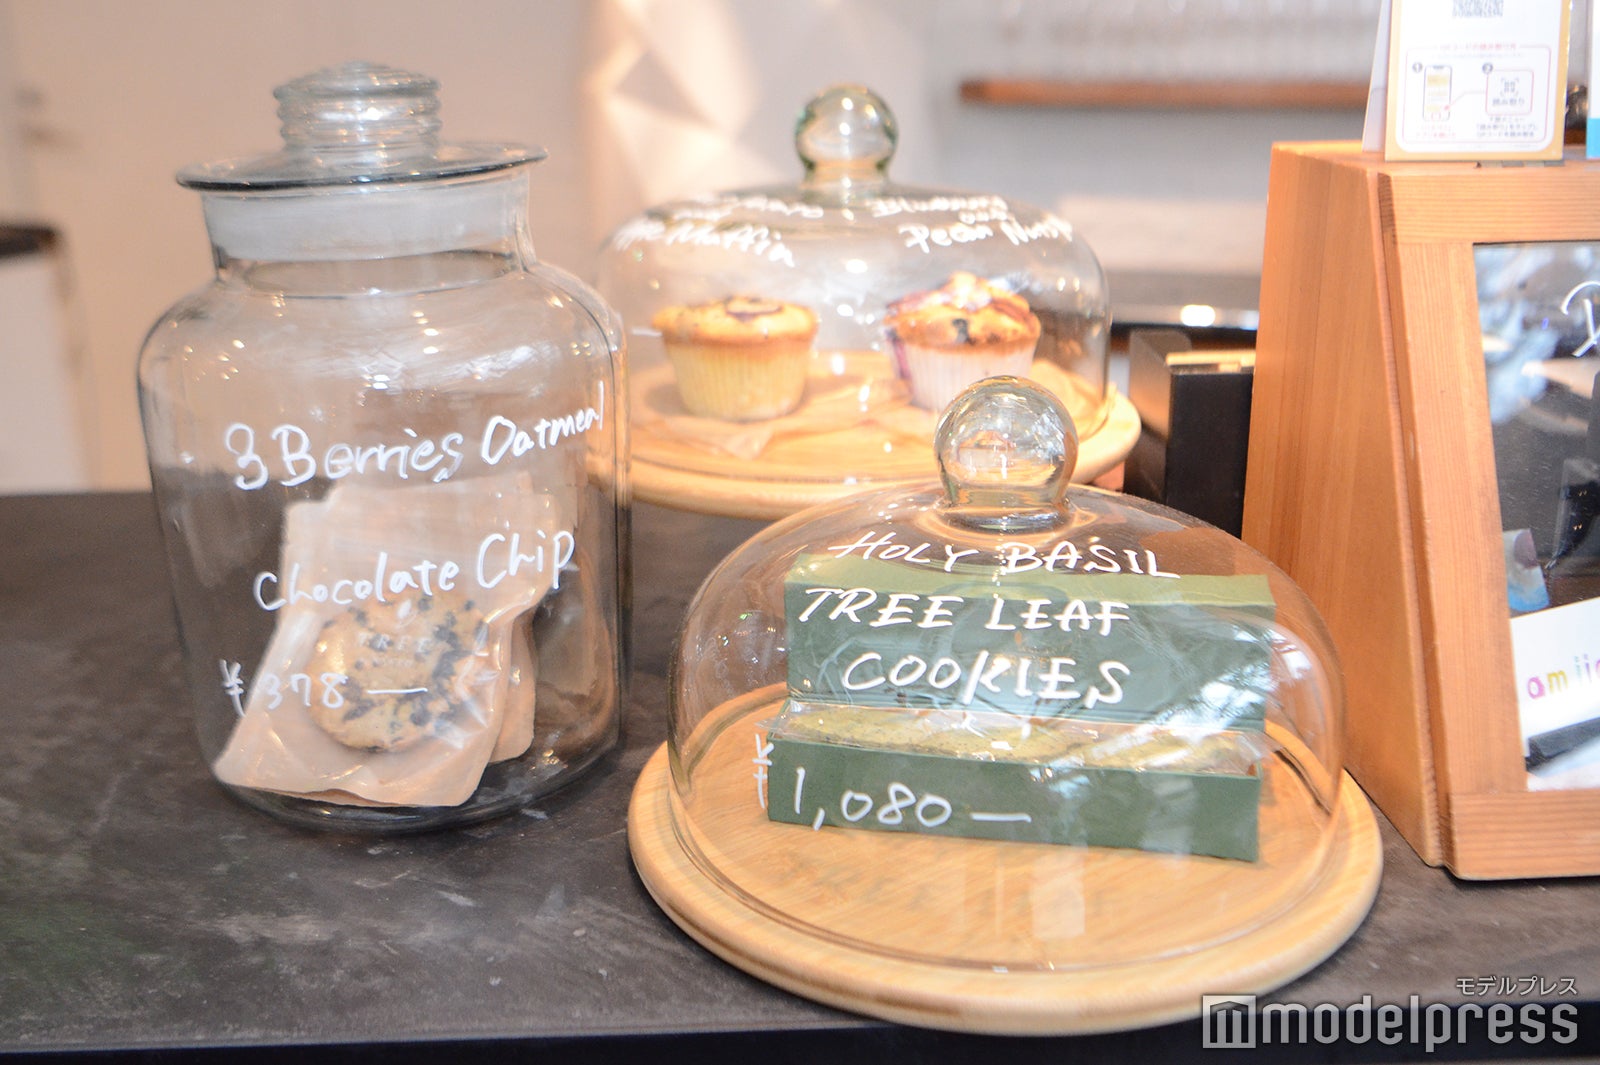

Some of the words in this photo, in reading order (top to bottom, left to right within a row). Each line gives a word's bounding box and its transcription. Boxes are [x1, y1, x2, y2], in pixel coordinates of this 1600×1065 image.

[225, 422, 269, 491] 3
[271, 424, 464, 484] Berries
[480, 380, 605, 465] Oatmeal
[253, 551, 460, 611] Chocolate
[476, 529, 576, 590] Chip
[1000, 536, 1181, 579] BASIL
[798, 587, 965, 629] TREE
[984, 593, 1130, 637] LEAF
[842, 650, 1131, 710] COOKIES
